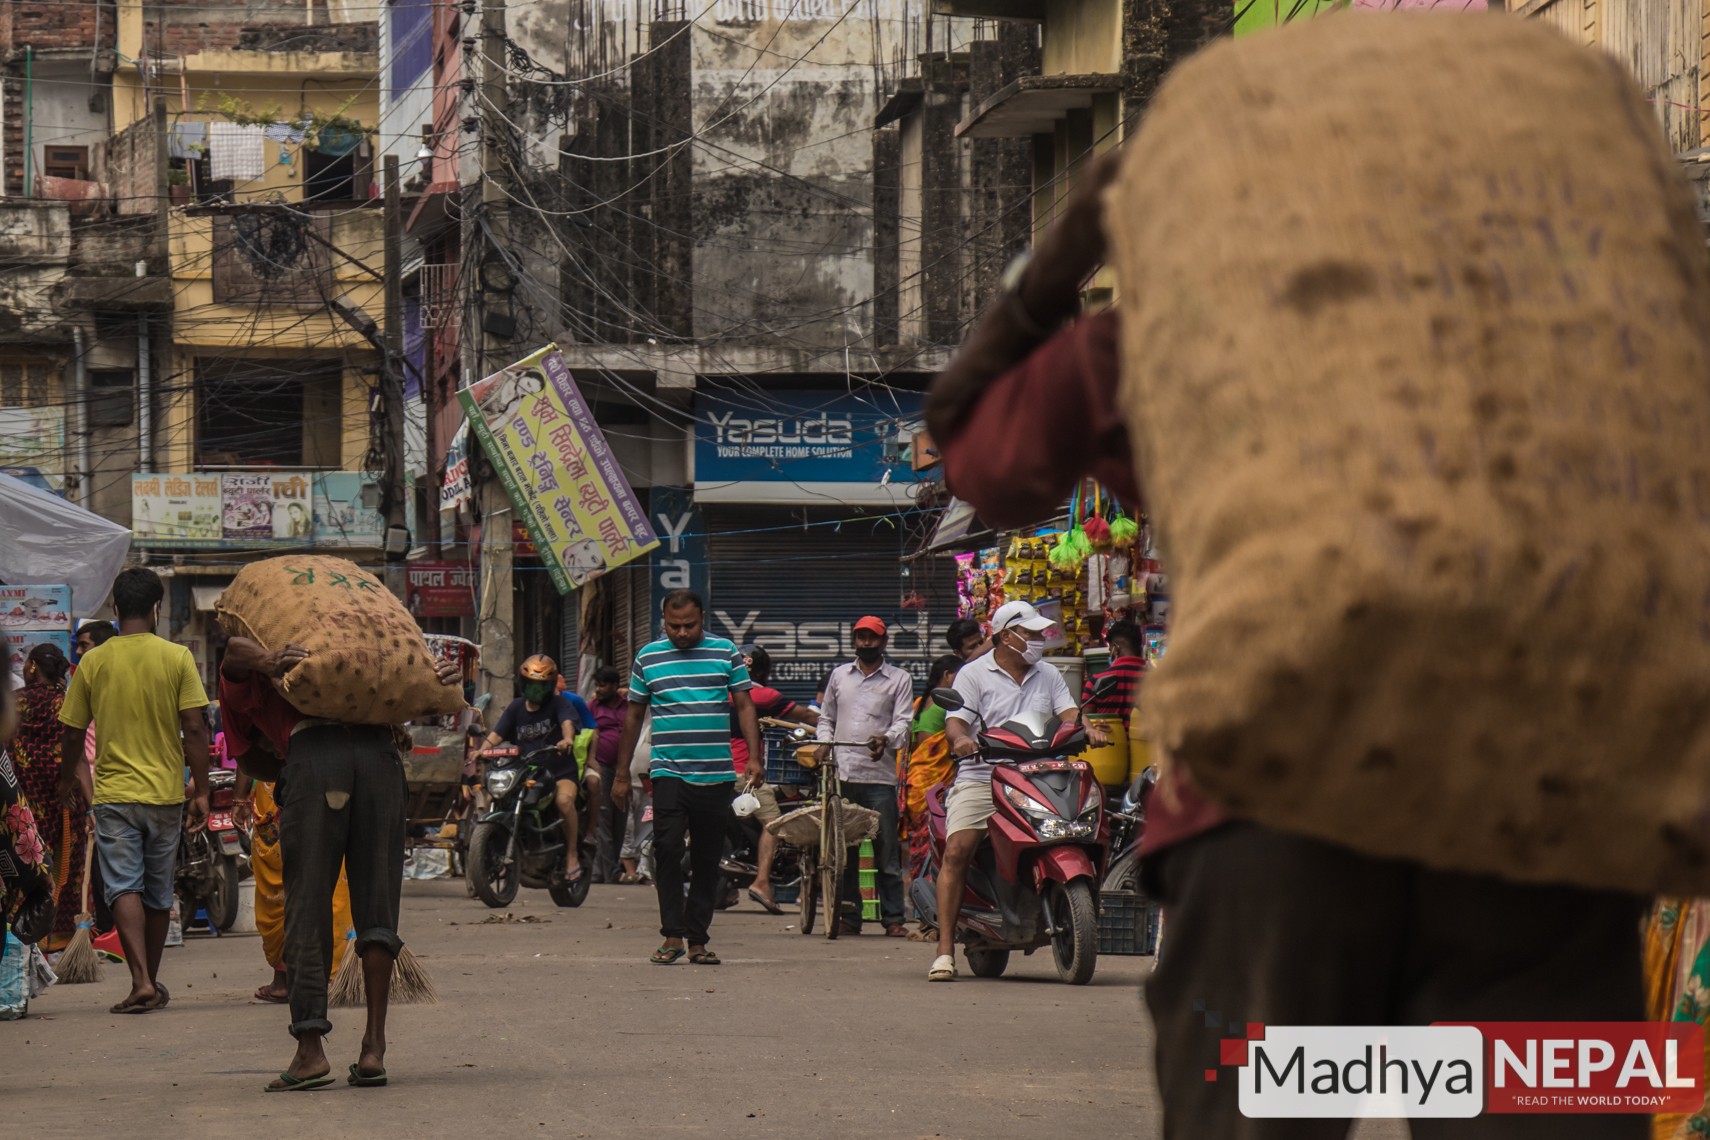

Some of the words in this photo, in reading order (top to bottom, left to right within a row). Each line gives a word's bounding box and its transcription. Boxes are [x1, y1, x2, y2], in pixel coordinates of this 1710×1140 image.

[707, 411, 852, 443] Yasuda
[717, 446, 740, 458] YOUR
[741, 446, 784, 458] COMPLETE
[785, 446, 810, 458] HOME
[811, 446, 852, 458] SOLUTION
[511, 416, 536, 450] एण्ड
[552, 493, 587, 540] सेन्टर
[527, 394, 558, 428] शुभ
[573, 477, 611, 520] ब्यूटी
[595, 513, 632, 559] पार्लर
